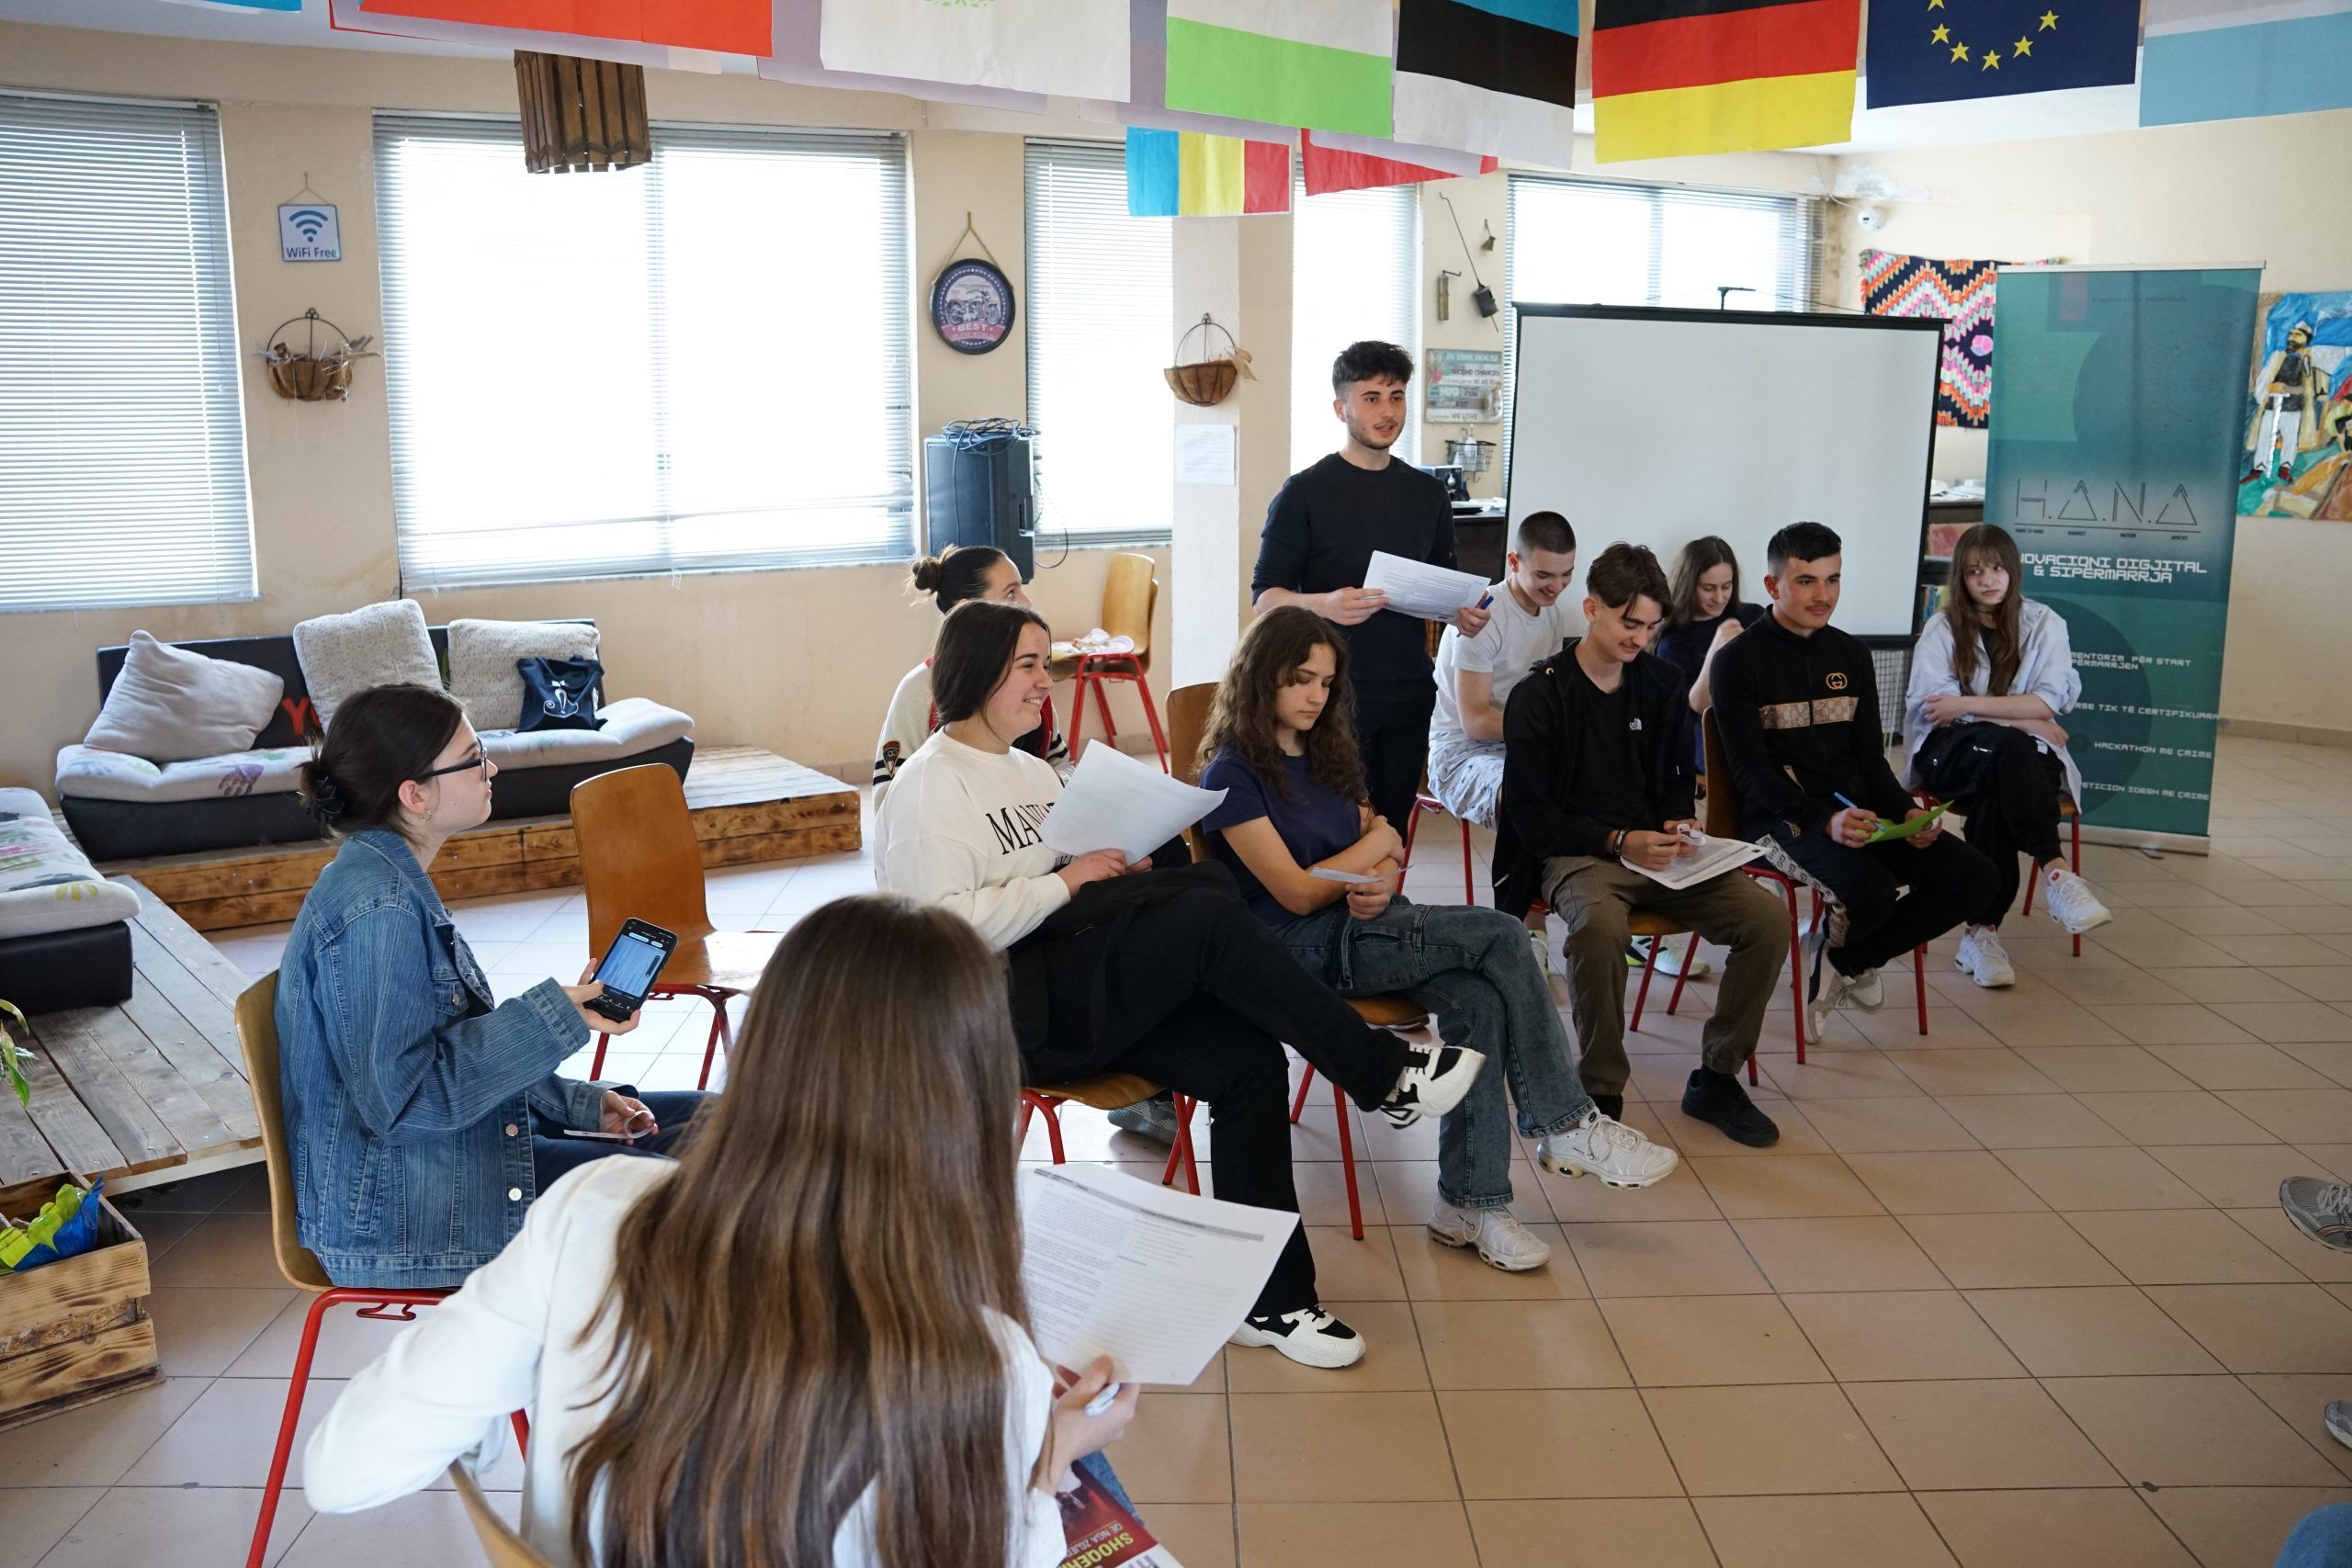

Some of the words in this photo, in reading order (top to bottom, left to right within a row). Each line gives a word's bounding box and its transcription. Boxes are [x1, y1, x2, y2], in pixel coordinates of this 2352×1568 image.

[286, 247, 311, 258] WiFi
[314, 247, 337, 258] Free
[957, 322, 988, 332] BEST
[2116, 558, 2208, 573] DIGJITAL
[2033, 566, 2045, 577] &
[2156, 658, 2192, 667] START
[2098, 704, 2118, 712] TIK
[2094, 741, 2156, 753] HACKATHON
[2159, 747, 2174, 755] ME
[2162, 789, 2175, 797] ME
